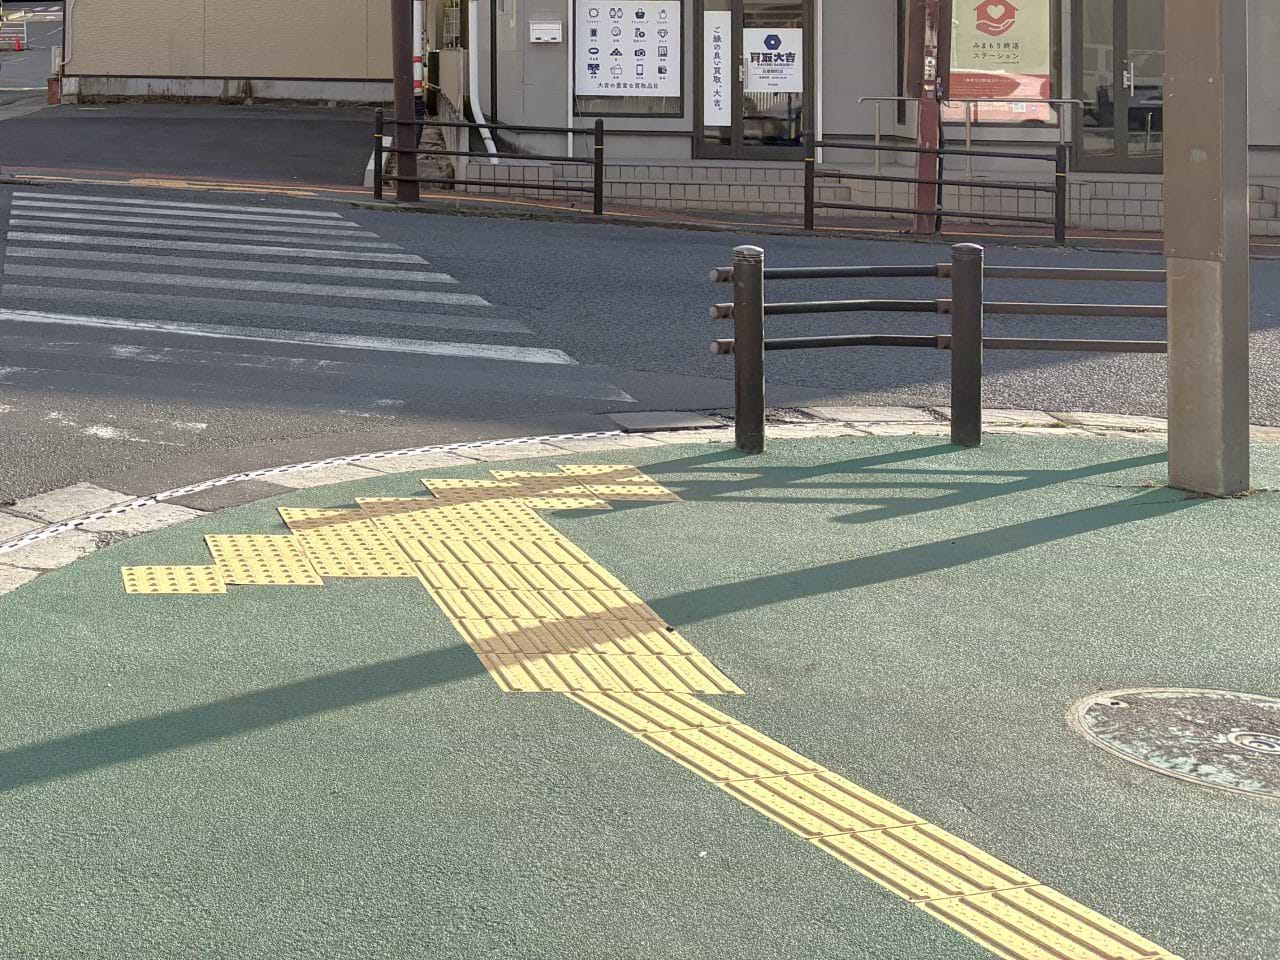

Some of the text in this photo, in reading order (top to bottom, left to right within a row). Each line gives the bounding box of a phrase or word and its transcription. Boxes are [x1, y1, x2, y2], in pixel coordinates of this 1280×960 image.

[972, 42, 1020, 50] みまもり終活
[750, 51, 796, 64] 買取大吉
[973, 52, 1020, 60] ステーション
